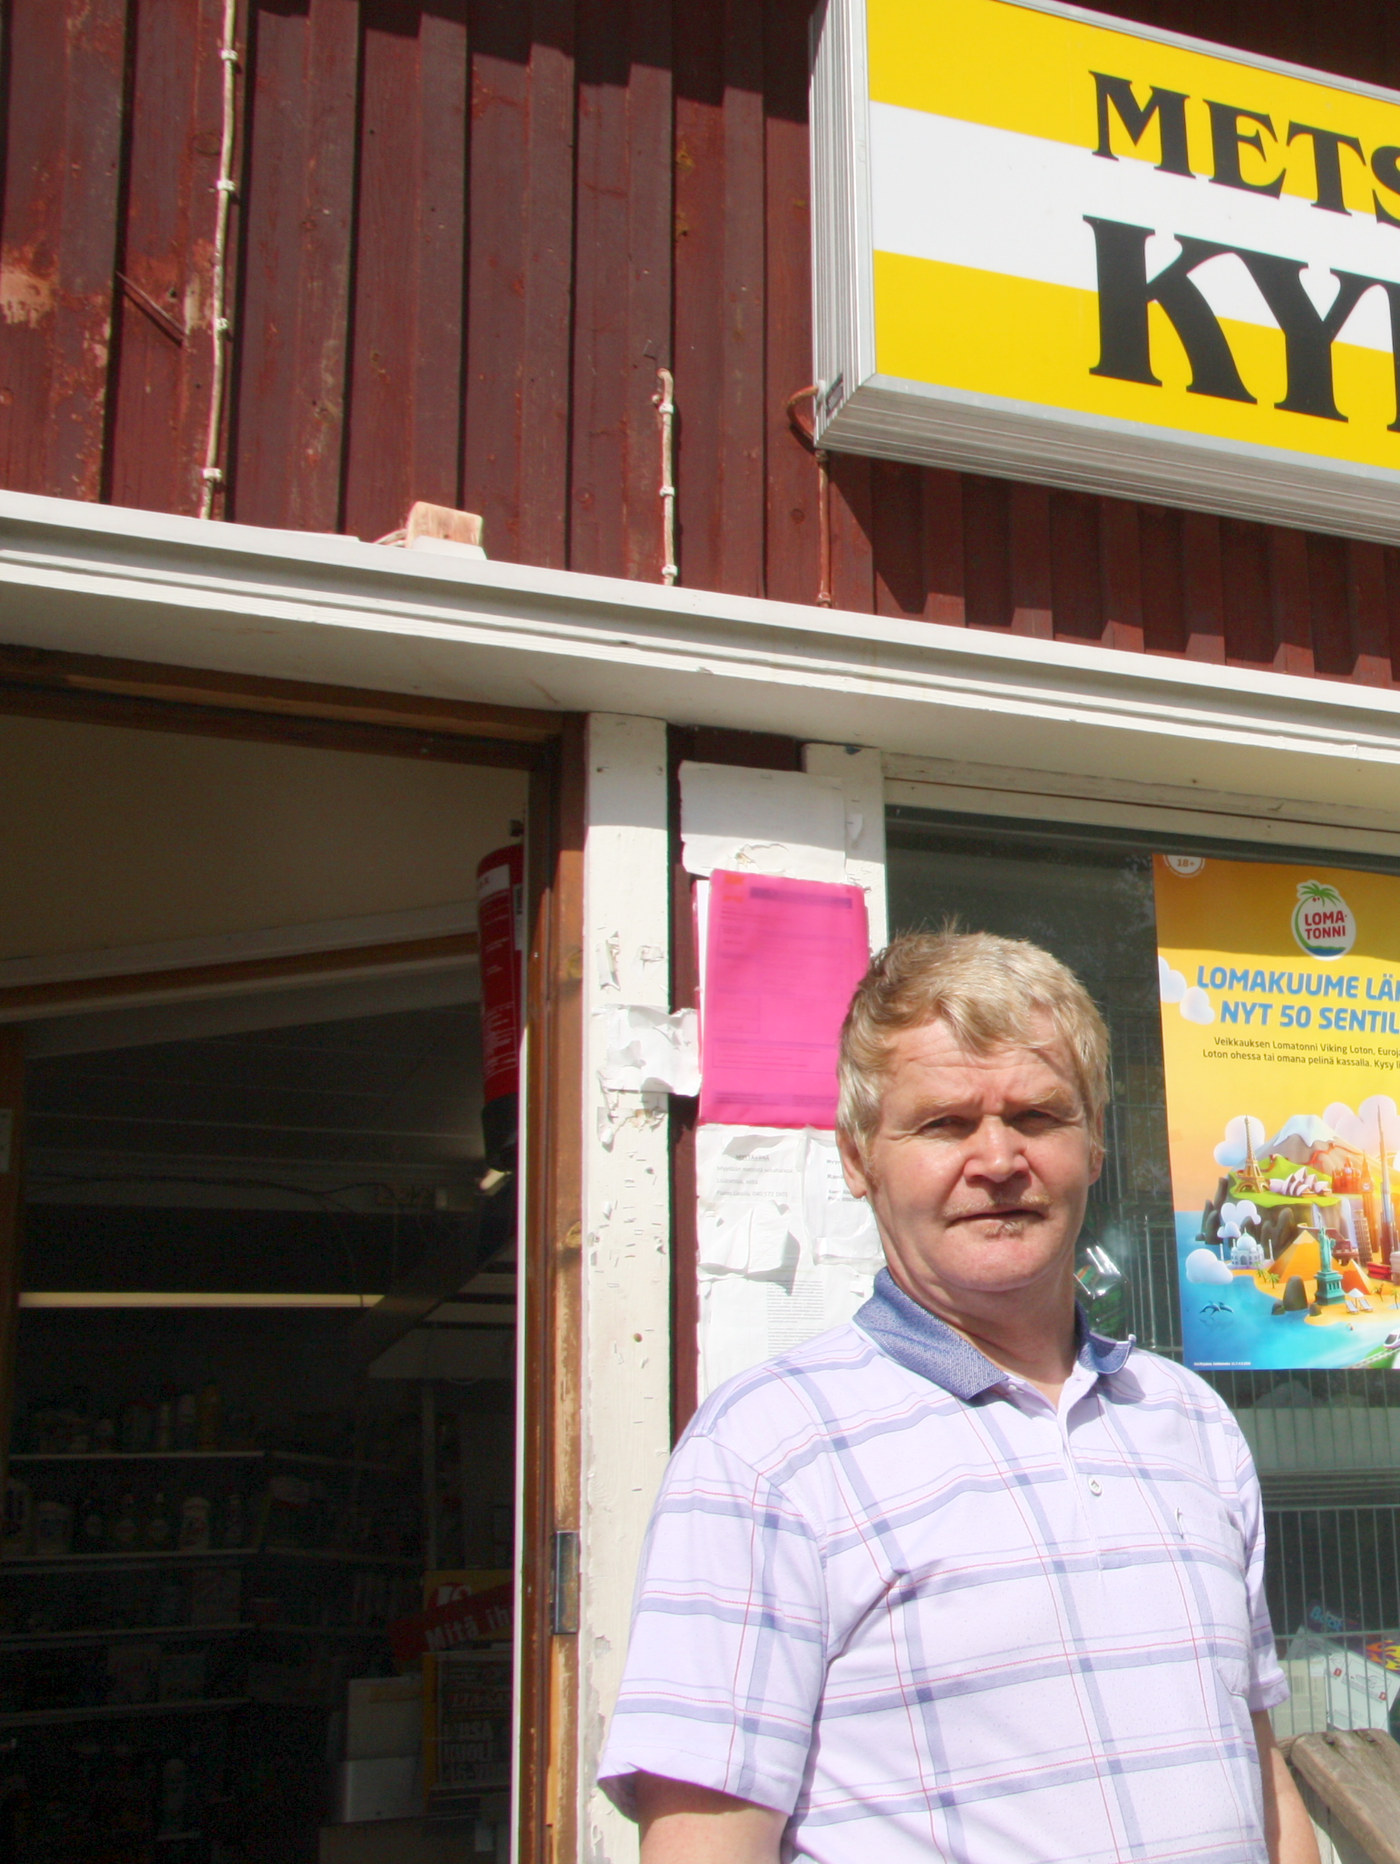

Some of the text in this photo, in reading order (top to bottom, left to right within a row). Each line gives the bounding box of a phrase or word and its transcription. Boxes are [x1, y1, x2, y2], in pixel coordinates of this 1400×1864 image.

[1305, 925, 1346, 940] TONNI
[1197, 966, 1360, 998] LOMAKUUME
[1220, 1001, 1273, 1026] NYT
[1279, 1004, 1312, 1028] 50
[1214, 1036, 1270, 1049] Veikkauksen
[1272, 1041, 1318, 1051] Lomatonni
[1320, 1043, 1348, 1054] Viking
[1203, 1049, 1229, 1058] Loton
[1230, 1051, 1262, 1061] ohessa
[1264, 1053, 1275, 1062] tai
[1277, 1055, 1306, 1064] omana
[1308, 1055, 1334, 1066] pelinä
[1374, 1059, 1395, 1071] Kysy
